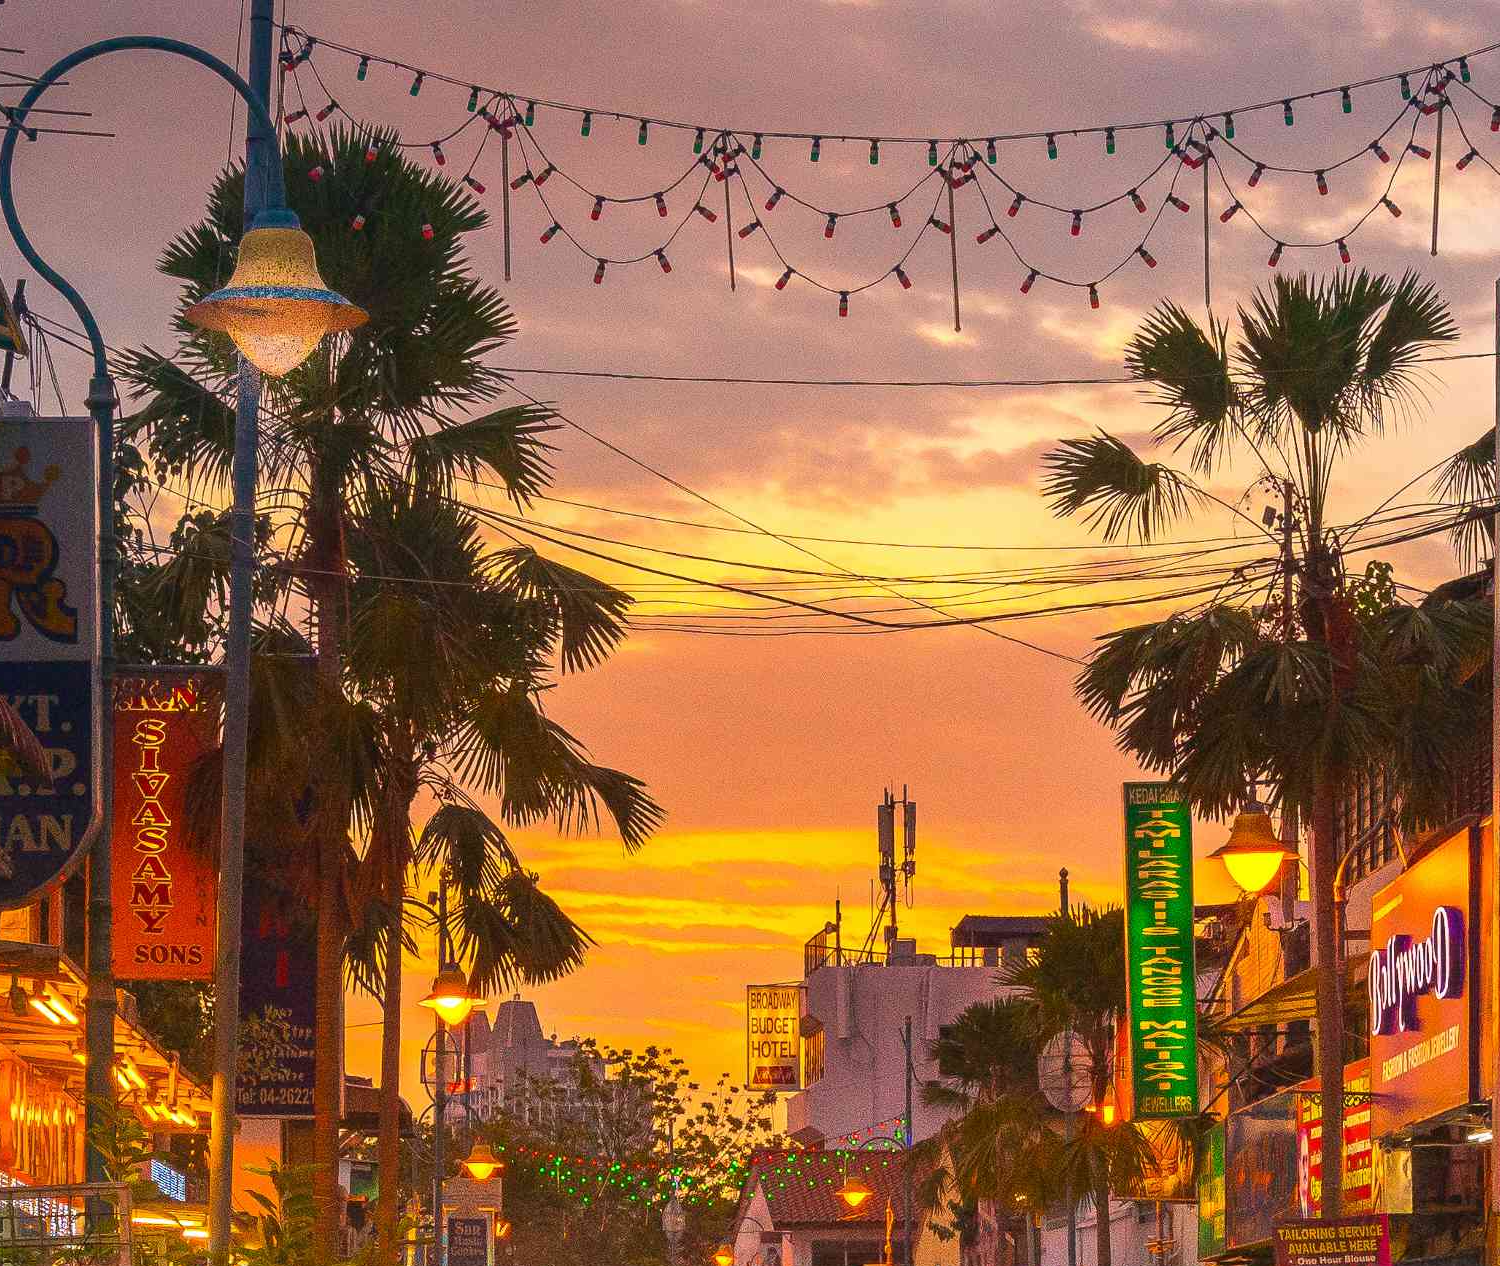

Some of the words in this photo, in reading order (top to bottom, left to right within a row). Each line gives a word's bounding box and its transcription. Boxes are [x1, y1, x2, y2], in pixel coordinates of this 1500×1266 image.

[131, 719, 173, 933] SIVASAMY
[134, 943, 205, 966] SONS
[1140, 946, 1183, 1008] TANGGE
[750, 992, 797, 1010] BROADWAY
[751, 1017, 797, 1034] BUDGET
[751, 1040, 797, 1058] HOTEL
[1140, 1020, 1187, 1091] MALIGAI
[1277, 1227, 1336, 1241] TAILORING
[1338, 1224, 1384, 1238] SERVICE
[1288, 1241, 1347, 1255] AVAILABLE
[1348, 1239, 1378, 1252] HERE
[1297, 1257, 1318, 1265] One
[1319, 1256, 1342, 1265] Hour
[1344, 1254, 1377, 1264] Blouse
